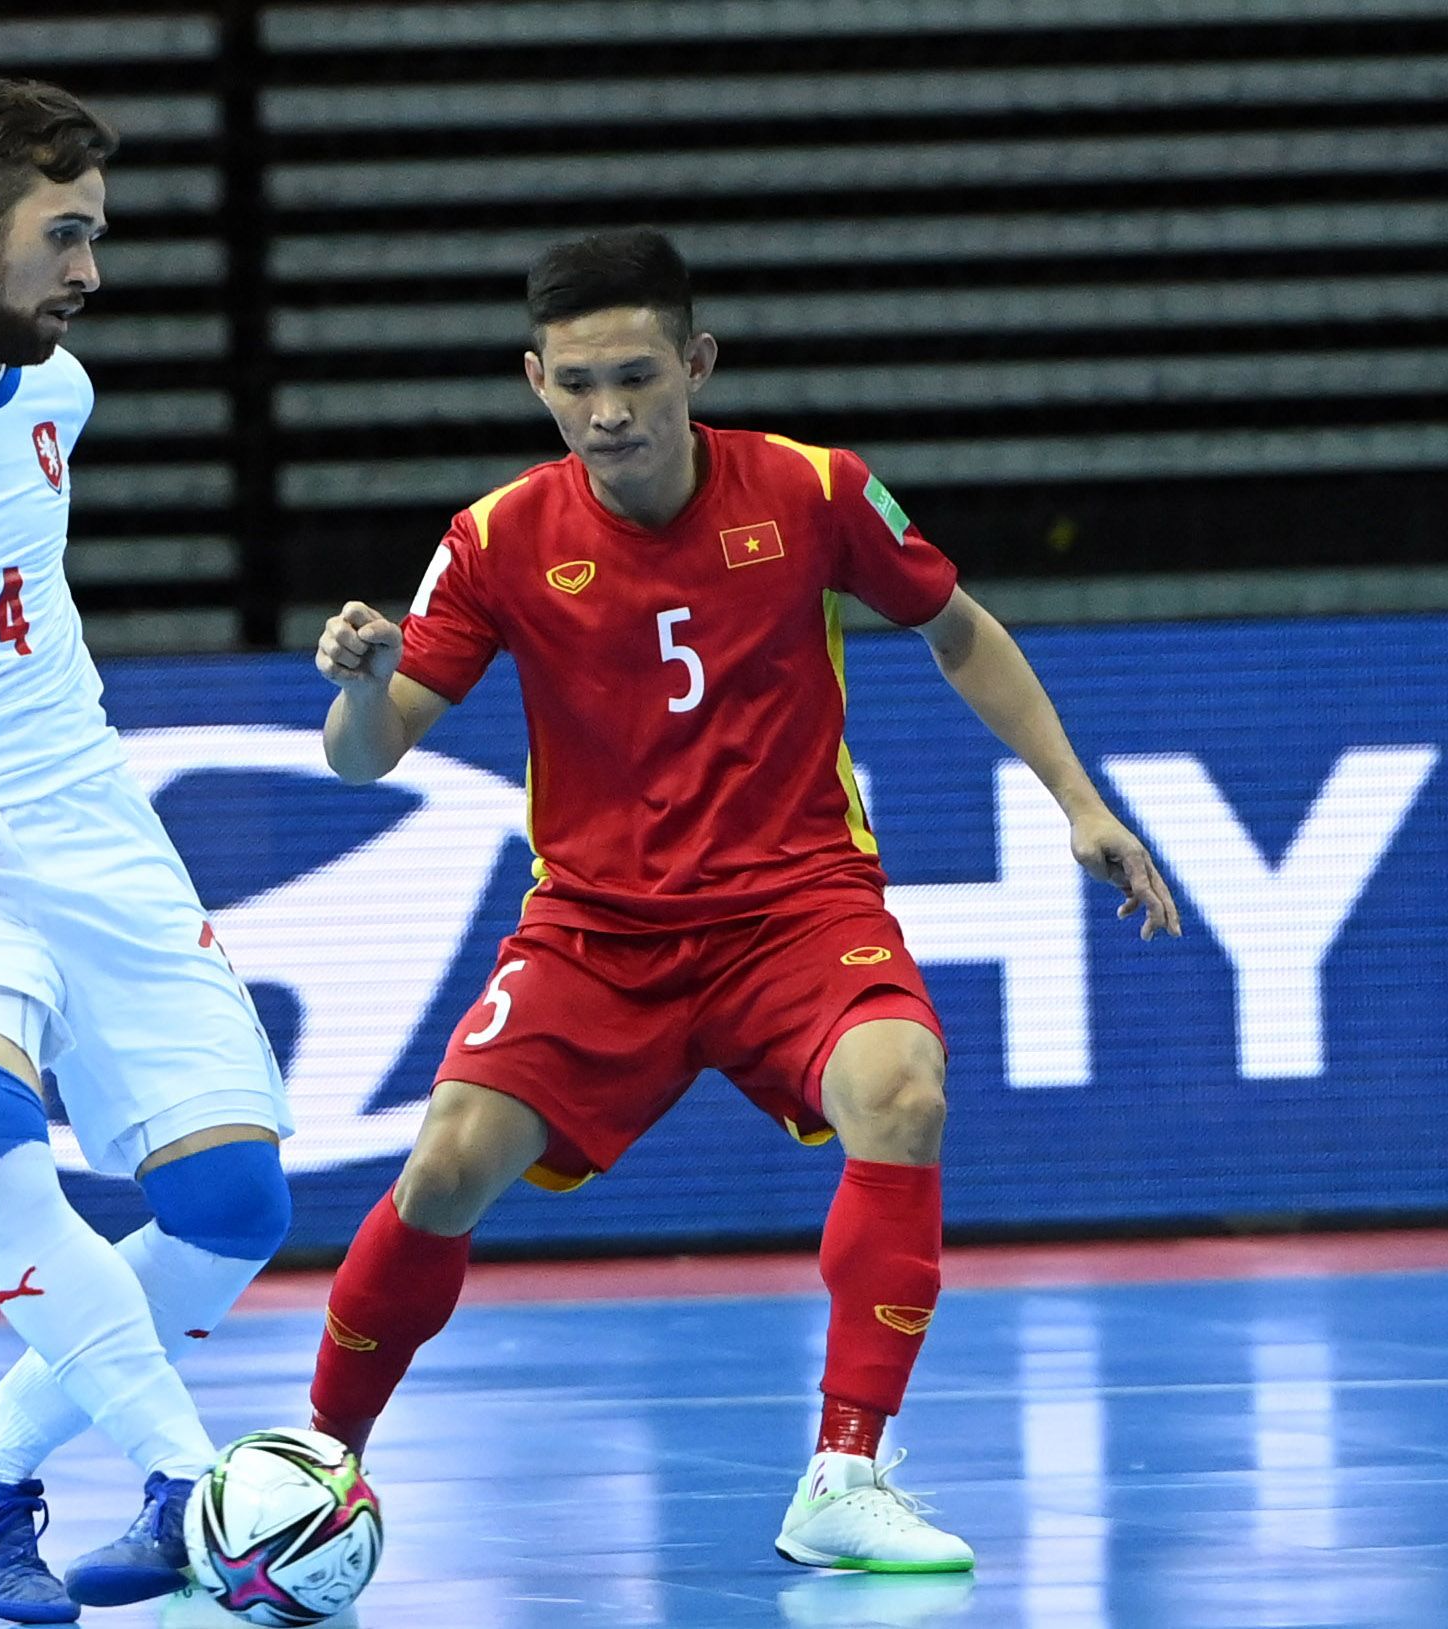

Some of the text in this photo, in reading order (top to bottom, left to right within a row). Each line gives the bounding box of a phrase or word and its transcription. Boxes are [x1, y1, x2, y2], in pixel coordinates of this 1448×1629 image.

[656, 606, 705, 712] 5
[850, 743, 1442, 1090] HY
[463, 959, 527, 1046] 5
